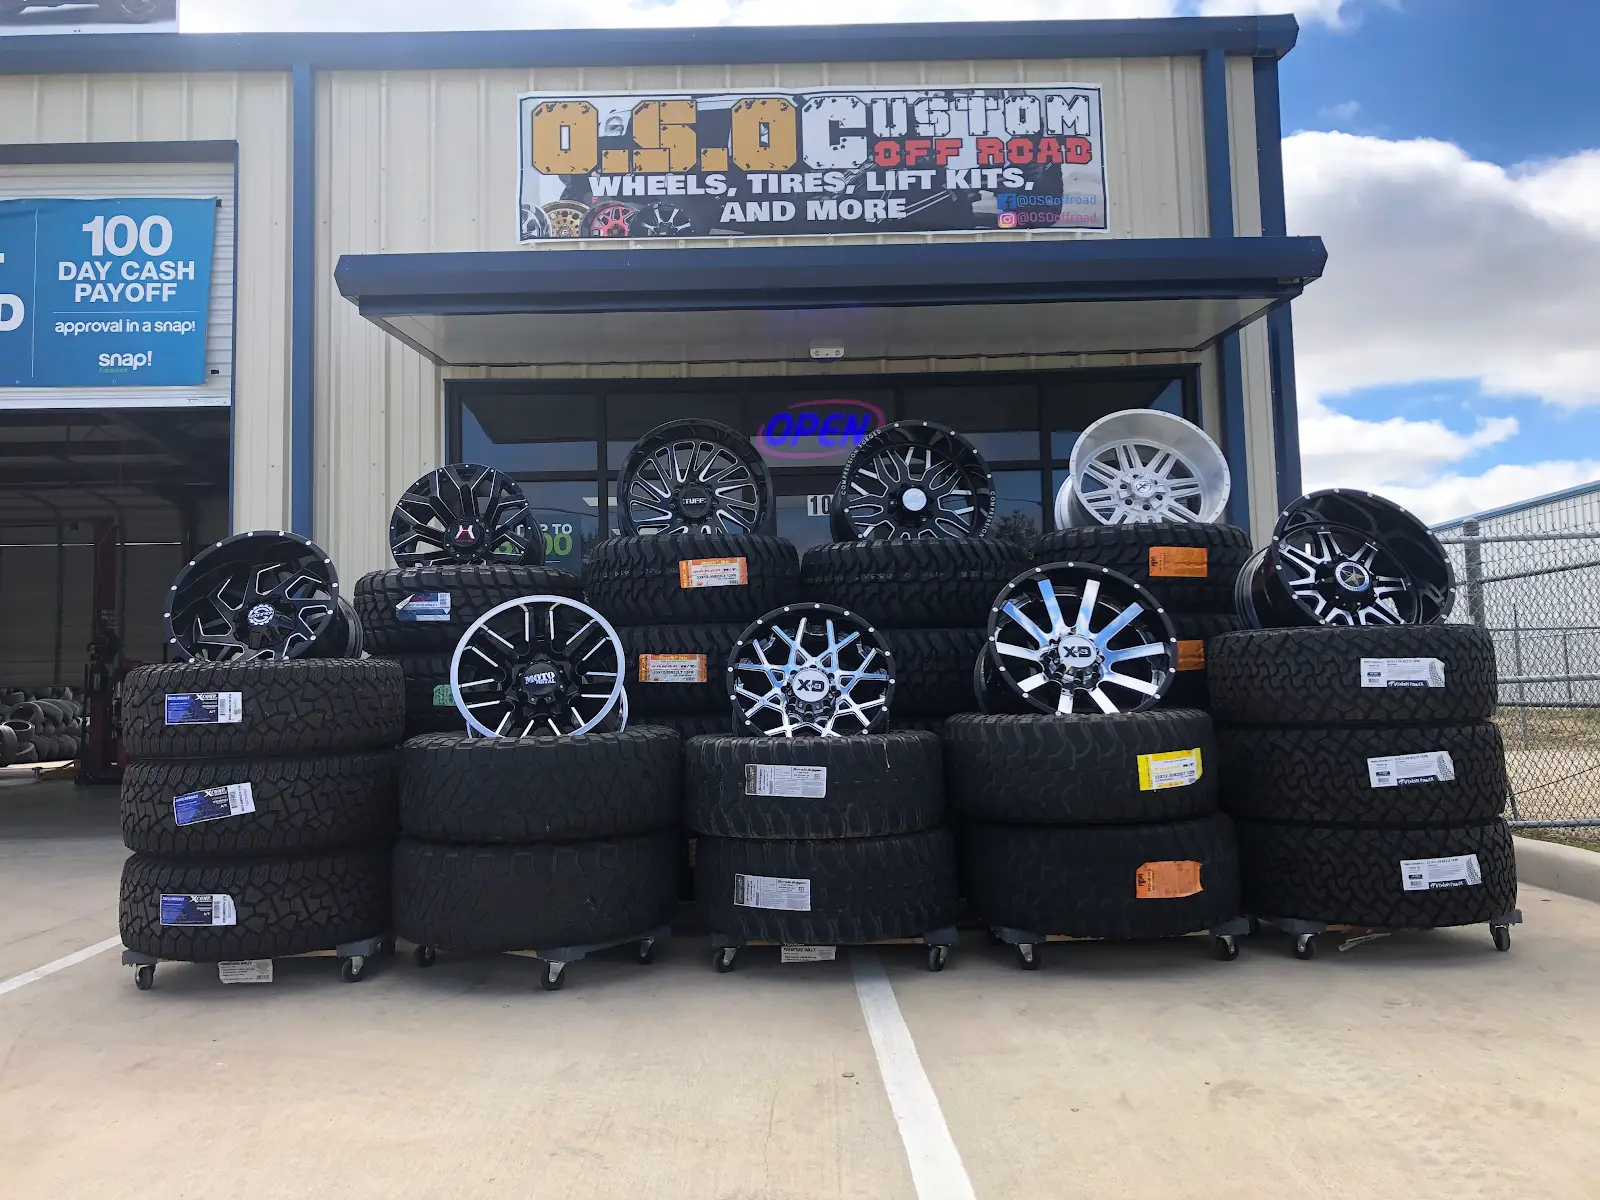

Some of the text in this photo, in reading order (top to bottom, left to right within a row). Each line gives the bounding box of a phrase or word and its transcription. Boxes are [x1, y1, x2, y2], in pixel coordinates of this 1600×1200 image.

[874, 136, 1093, 167] OFF ROAD
[588, 167, 1035, 197] WHEELS, TIRES, LIFT KITS,
[720, 198, 907, 223] AND MORE
[82, 215, 173, 257] 100
[58, 260, 195, 281] DAY CASH
[74, 282, 178, 303] PAYOFF
[54, 319, 196, 336] approval in a snap!
[98, 351, 153, 370] snap!
[764, 411, 872, 448] OPEN
[551, 523, 573, 535] TO
[524, 671, 556, 685] MOTO
